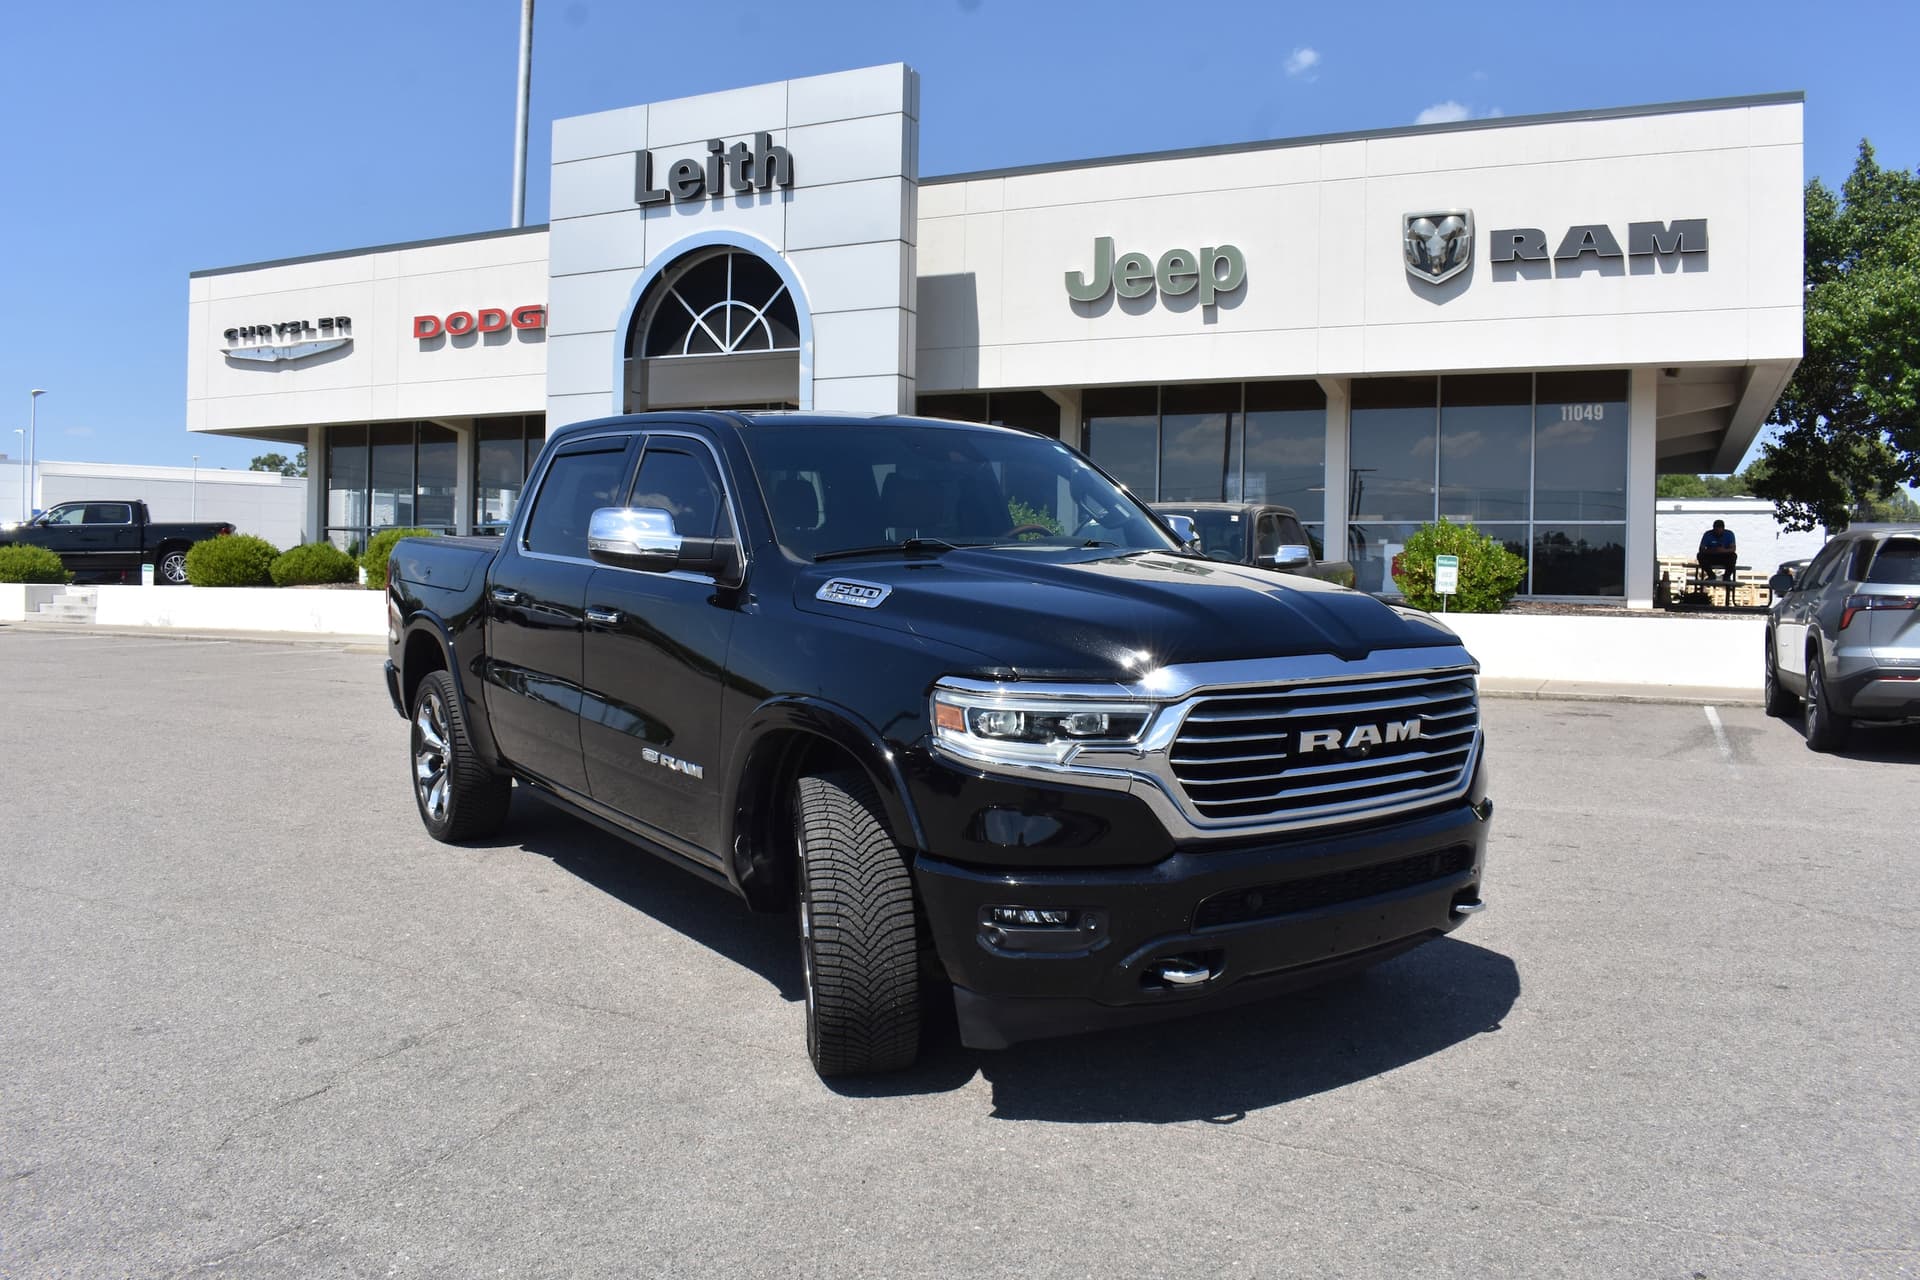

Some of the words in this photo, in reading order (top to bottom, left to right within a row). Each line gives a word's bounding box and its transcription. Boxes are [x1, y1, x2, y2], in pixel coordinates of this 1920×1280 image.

[635, 131, 793, 204] Leith
[1490, 218, 1709, 262] RAM
[1064, 236, 1247, 306] Jeep
[223, 315, 352, 342] CHRYSLER
[413, 303, 549, 339] DODG
[1561, 404, 1604, 421] 11049
[832, 583, 881, 599] 1500
[1299, 718, 1421, 753] RAM
[660, 753, 704, 780] RAM
